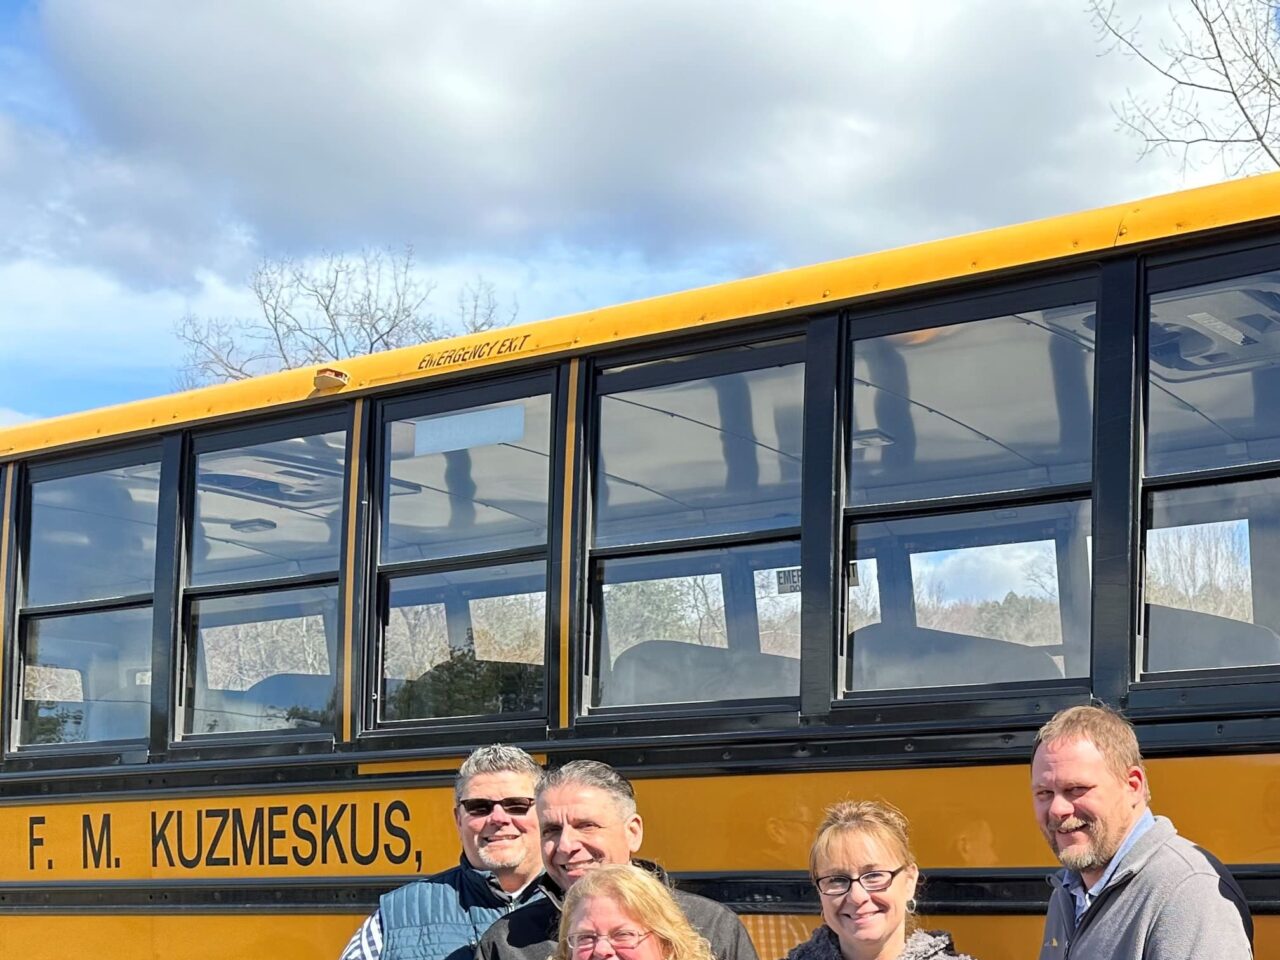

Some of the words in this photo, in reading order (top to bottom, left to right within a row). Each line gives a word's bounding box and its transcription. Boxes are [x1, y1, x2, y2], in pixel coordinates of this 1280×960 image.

[418, 341, 499, 370] EMERGENCY
[497, 334, 531, 355] EXIT
[28, 816, 53, 870] F.
[82, 813, 121, 869] M.
[151, 800, 423, 872] KUZMESKUS,
